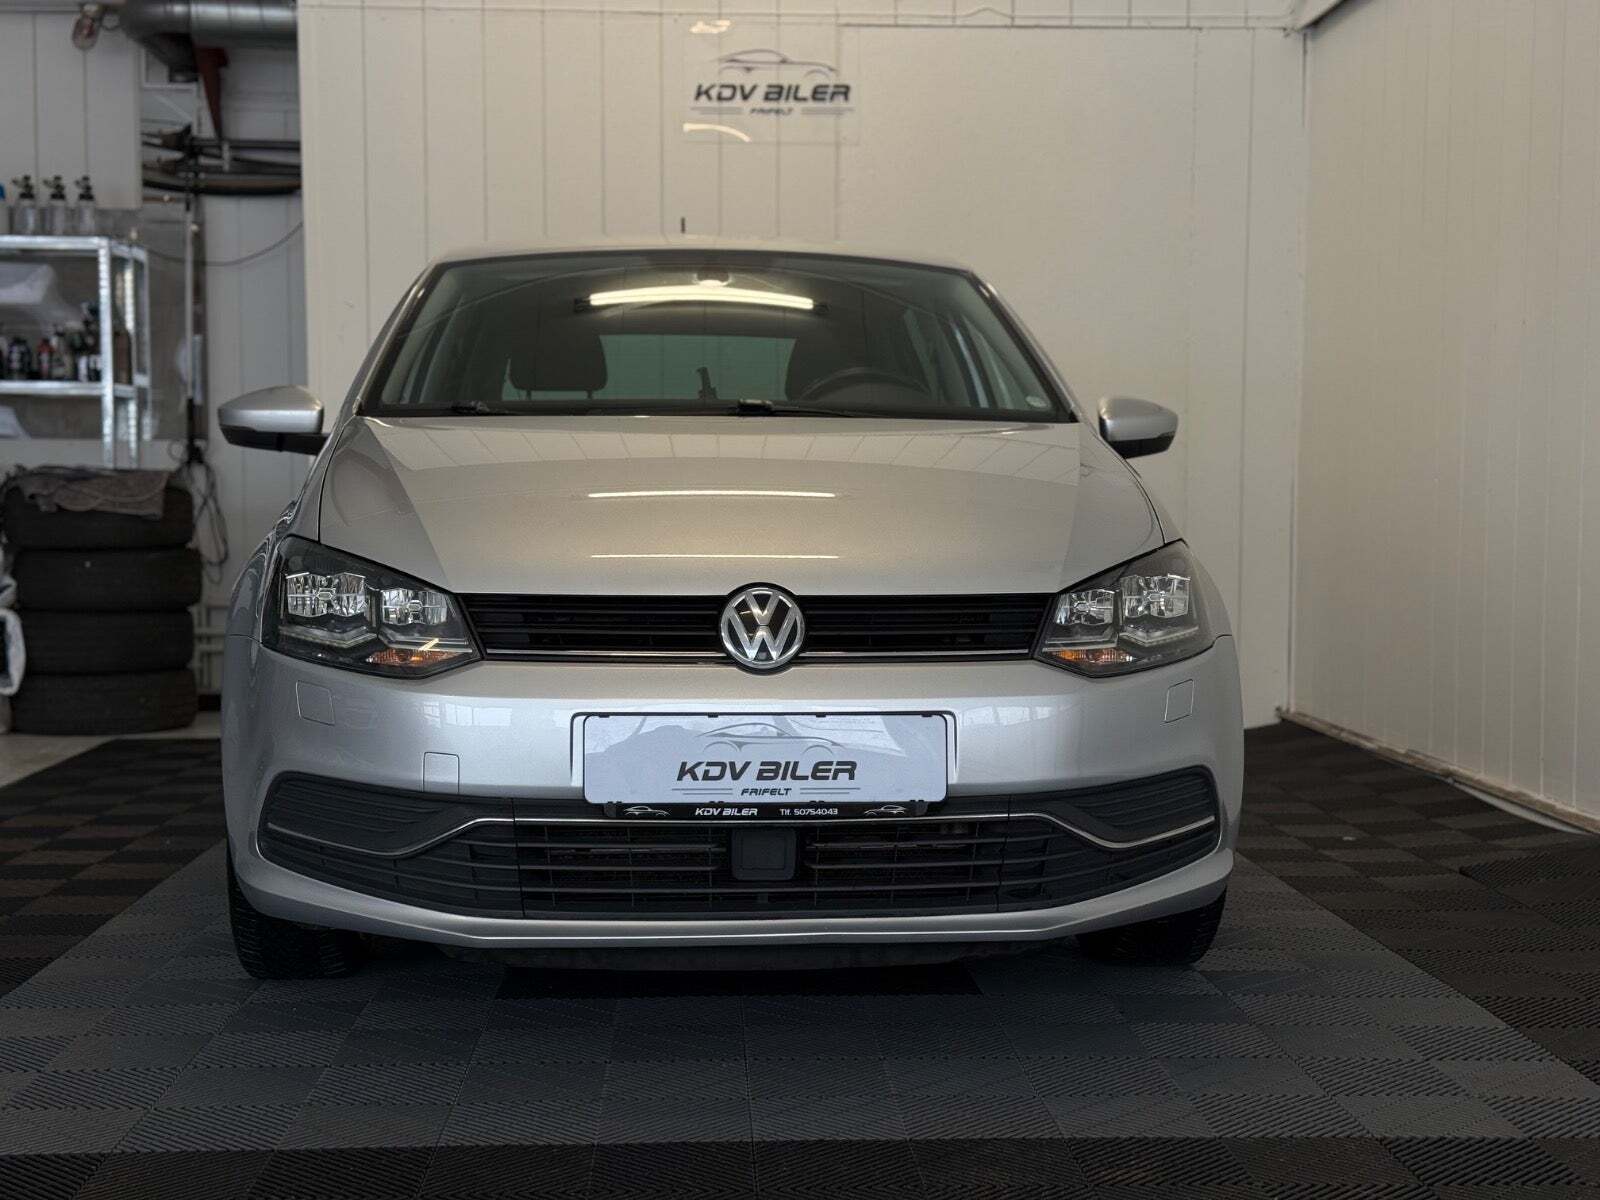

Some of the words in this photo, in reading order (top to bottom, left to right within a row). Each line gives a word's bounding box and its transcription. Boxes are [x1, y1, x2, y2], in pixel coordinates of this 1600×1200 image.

[694, 84, 758, 101] KDV
[764, 84, 851, 101] BILER
[677, 761, 752, 781] KDV
[756, 761, 858, 781] BILER
[741, 788, 792, 796] FRIFELT
[695, 808, 721, 816] KDV
[722, 808, 758, 816] BILER
